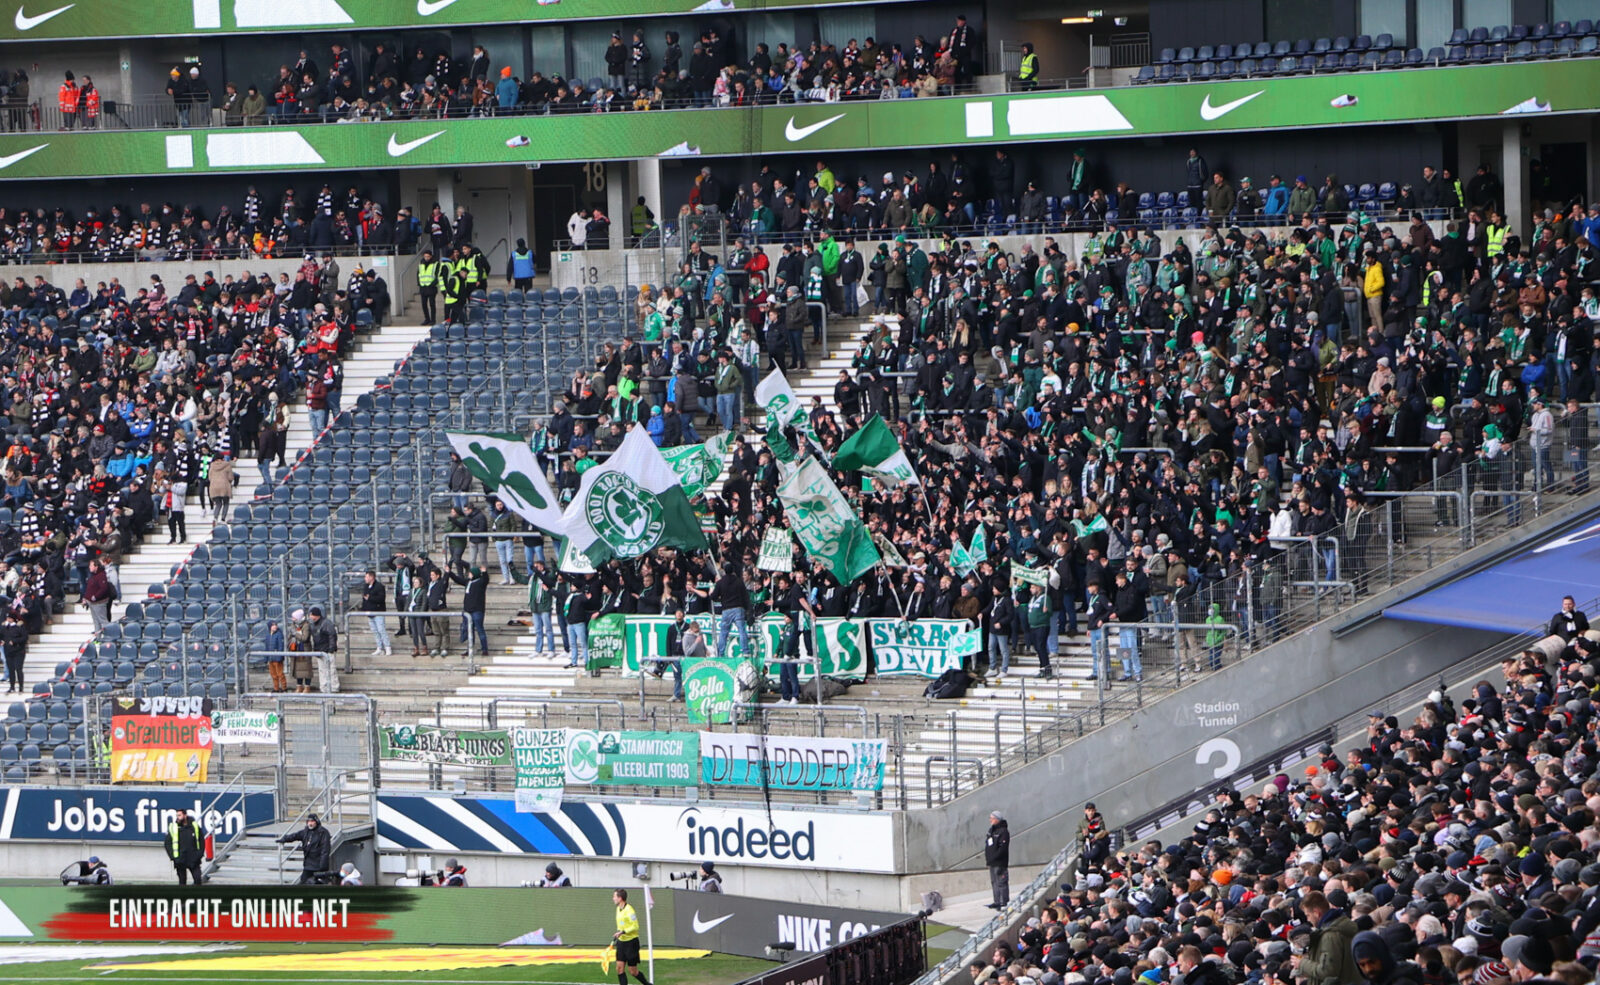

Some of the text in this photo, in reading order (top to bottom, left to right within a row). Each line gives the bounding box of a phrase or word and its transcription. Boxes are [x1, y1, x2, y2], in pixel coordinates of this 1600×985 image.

[583, 161, 605, 191] 18
[580, 266, 598, 284] 18
[877, 648, 960, 671] DEVIA
[688, 676, 724, 700] Bella
[1194, 701, 1239, 713] Stadion
[126, 720, 197, 744] Greuther
[1198, 714, 1237, 728] Tunnel
[516, 730, 567, 746] GUNZEN
[619, 739, 683, 756] STAMMTISCH
[116, 752, 178, 779] Fürth
[516, 749, 566, 766] HAUSEN
[712, 745, 733, 782] DI
[612, 761, 689, 779] KLEEBLATT 1903
[48, 798, 125, 833] Jobs
[687, 816, 814, 861] indeed
[778, 914, 831, 953] NIKE
